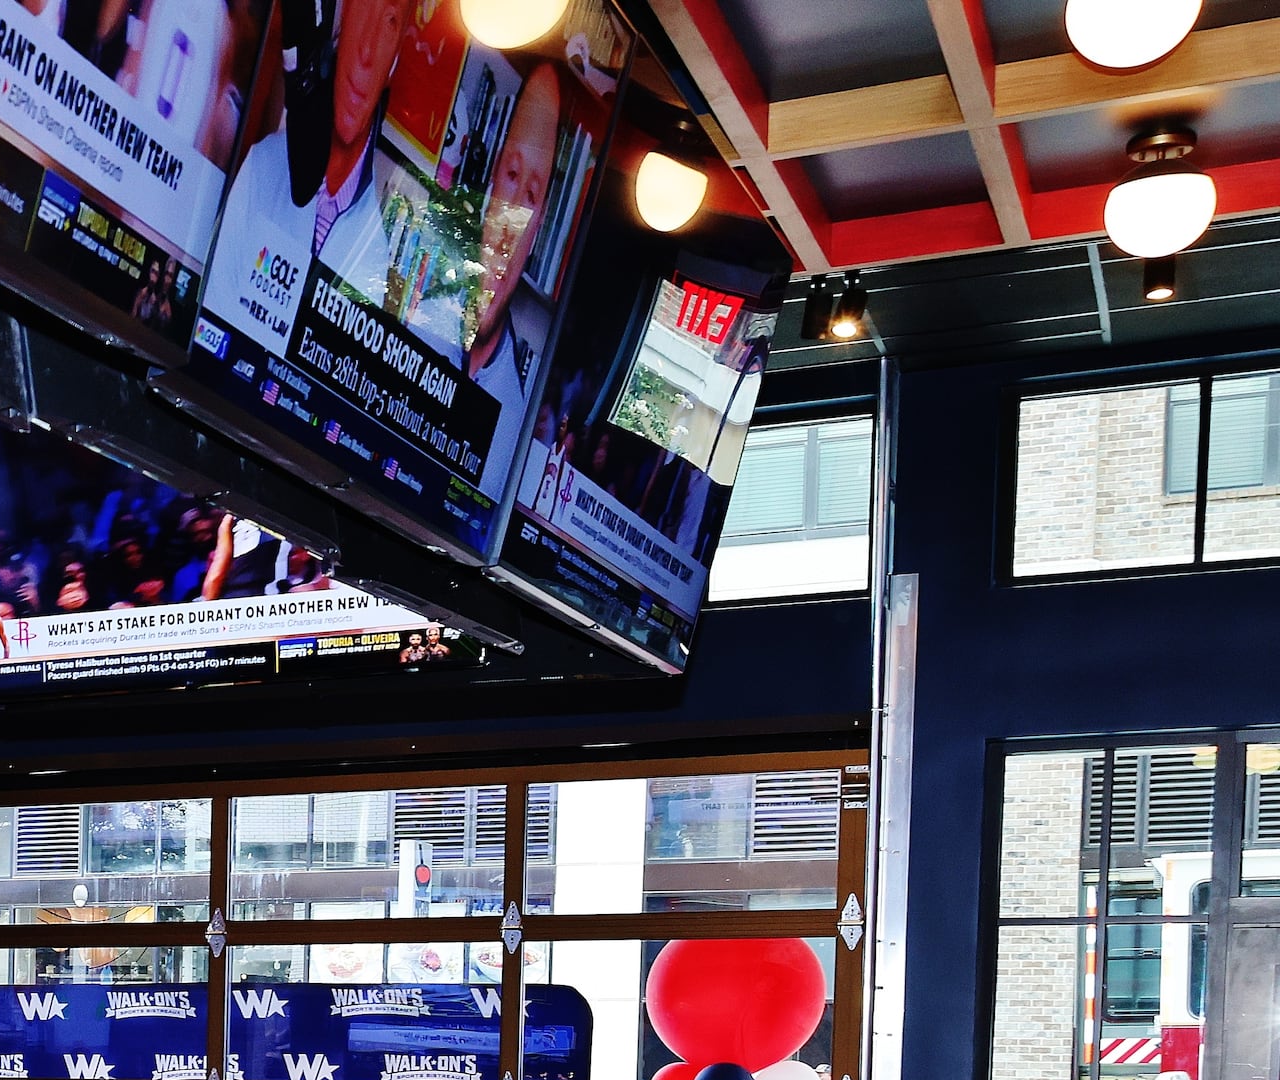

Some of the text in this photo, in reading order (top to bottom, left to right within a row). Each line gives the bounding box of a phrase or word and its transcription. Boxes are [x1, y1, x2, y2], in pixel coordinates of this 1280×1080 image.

[34, 52, 57, 94] ON
[54, 70, 117, 140] ANOTHER
[115, 116, 147, 162] NEW
[145, 138, 182, 190] TEAM?
[311, 278, 456, 408] FLEETWOOD SHORT AGAIN
[47, 595, 368, 635] WHAT'S AT STAKE FOR DURANT ON ANOTHER NEW
